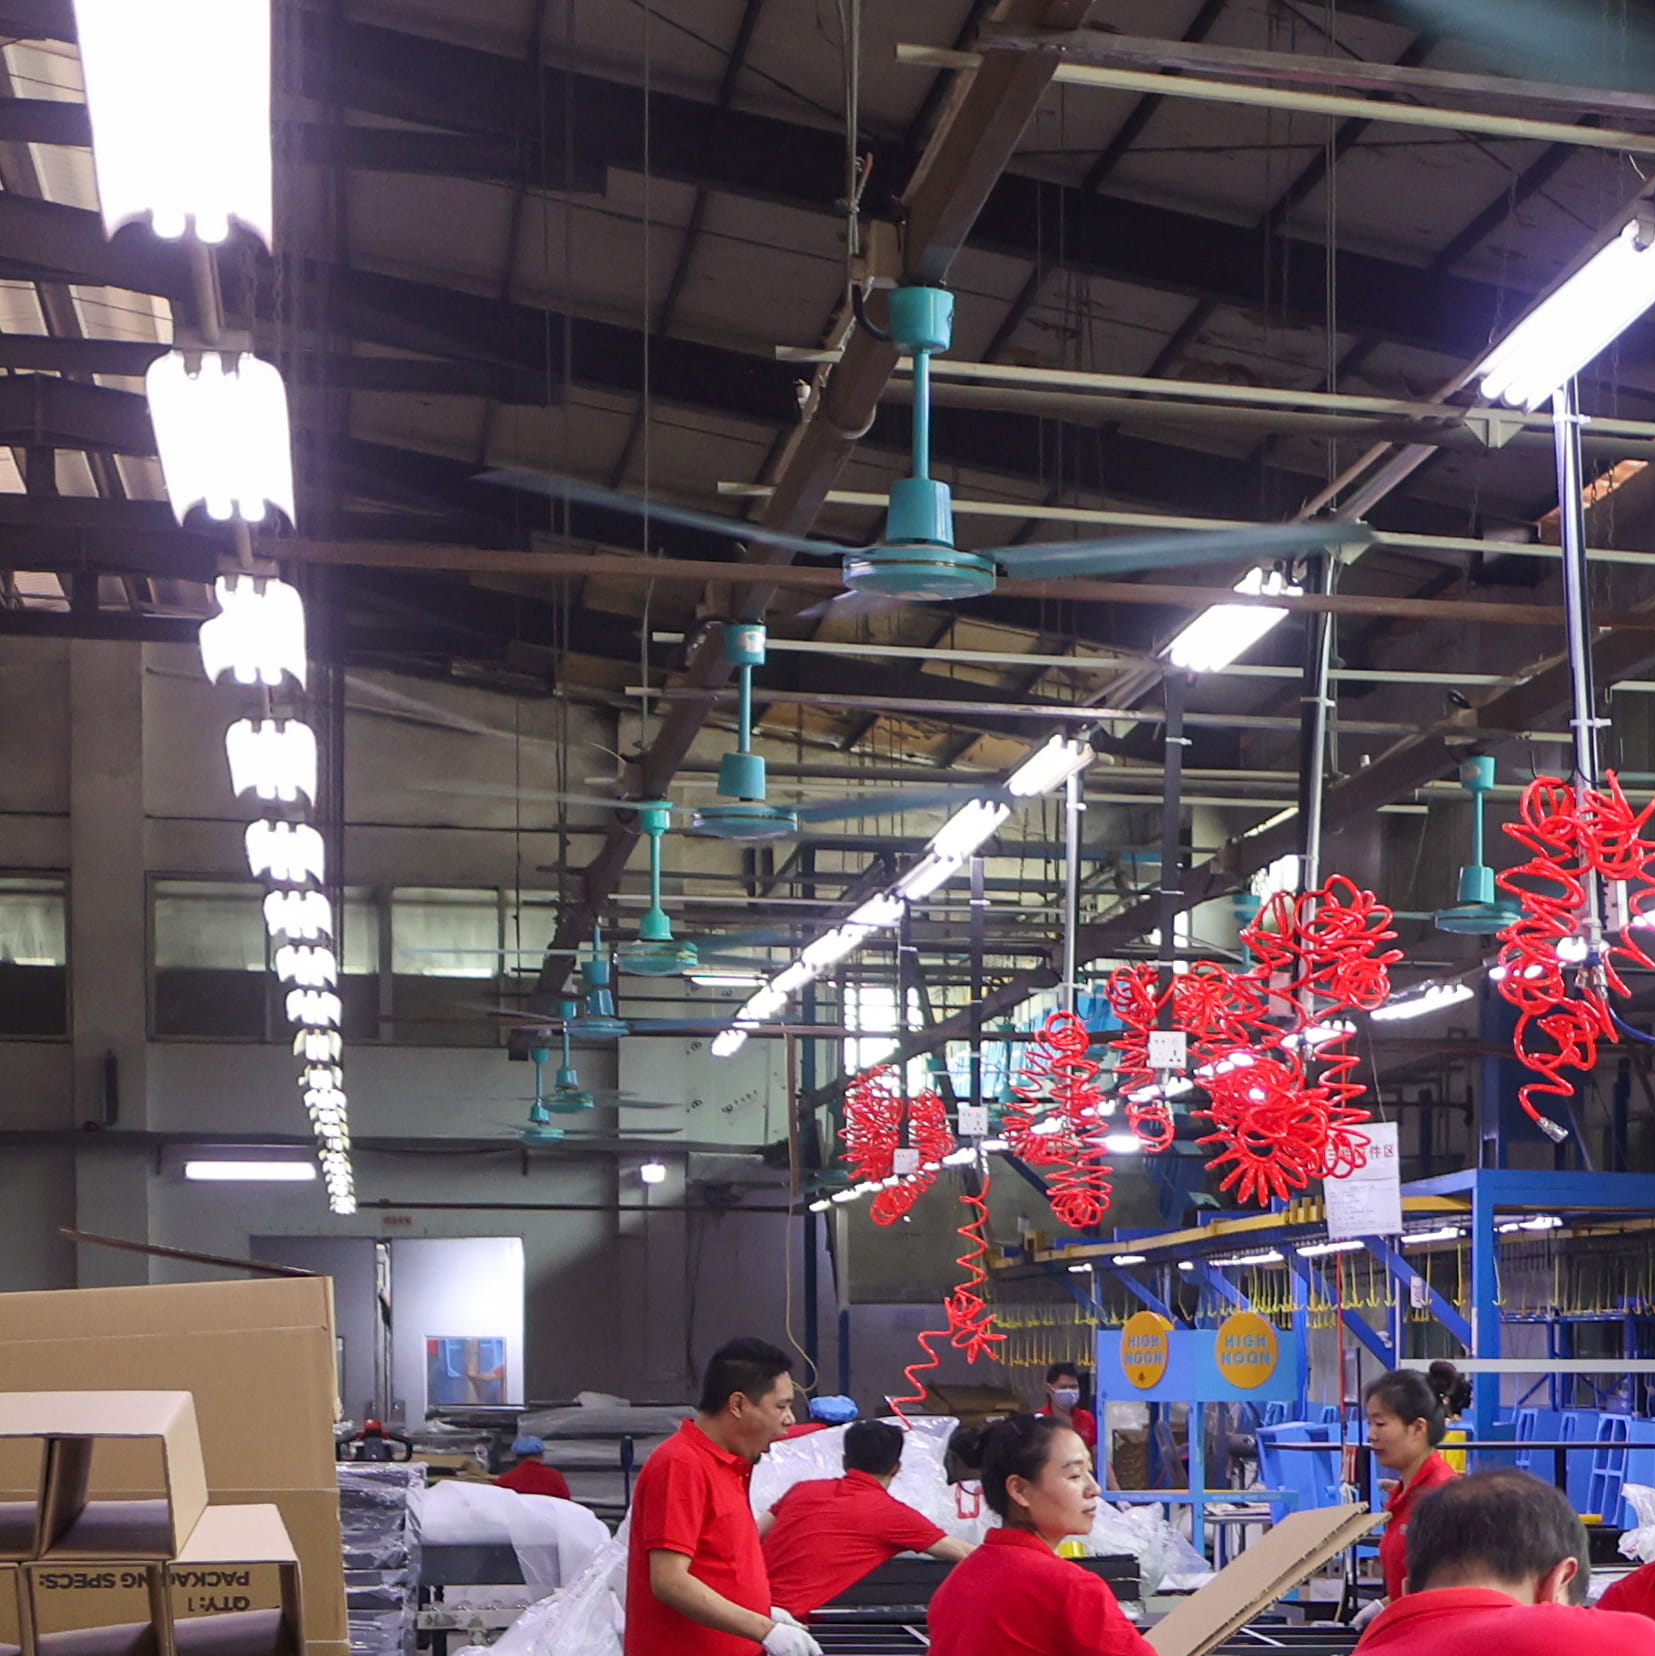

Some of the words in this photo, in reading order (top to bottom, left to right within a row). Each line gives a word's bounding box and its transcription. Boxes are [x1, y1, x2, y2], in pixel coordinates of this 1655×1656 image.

[1128, 1335, 1161, 1348] HIGH
[1225, 1335, 1268, 1348] HIGH
[1125, 1351, 1163, 1366] NOON
[1222, 1351, 1272, 1366] NOON
[40, 1572, 116, 1589] SPECS:
[200, 1596, 250, 1611] QTY:
